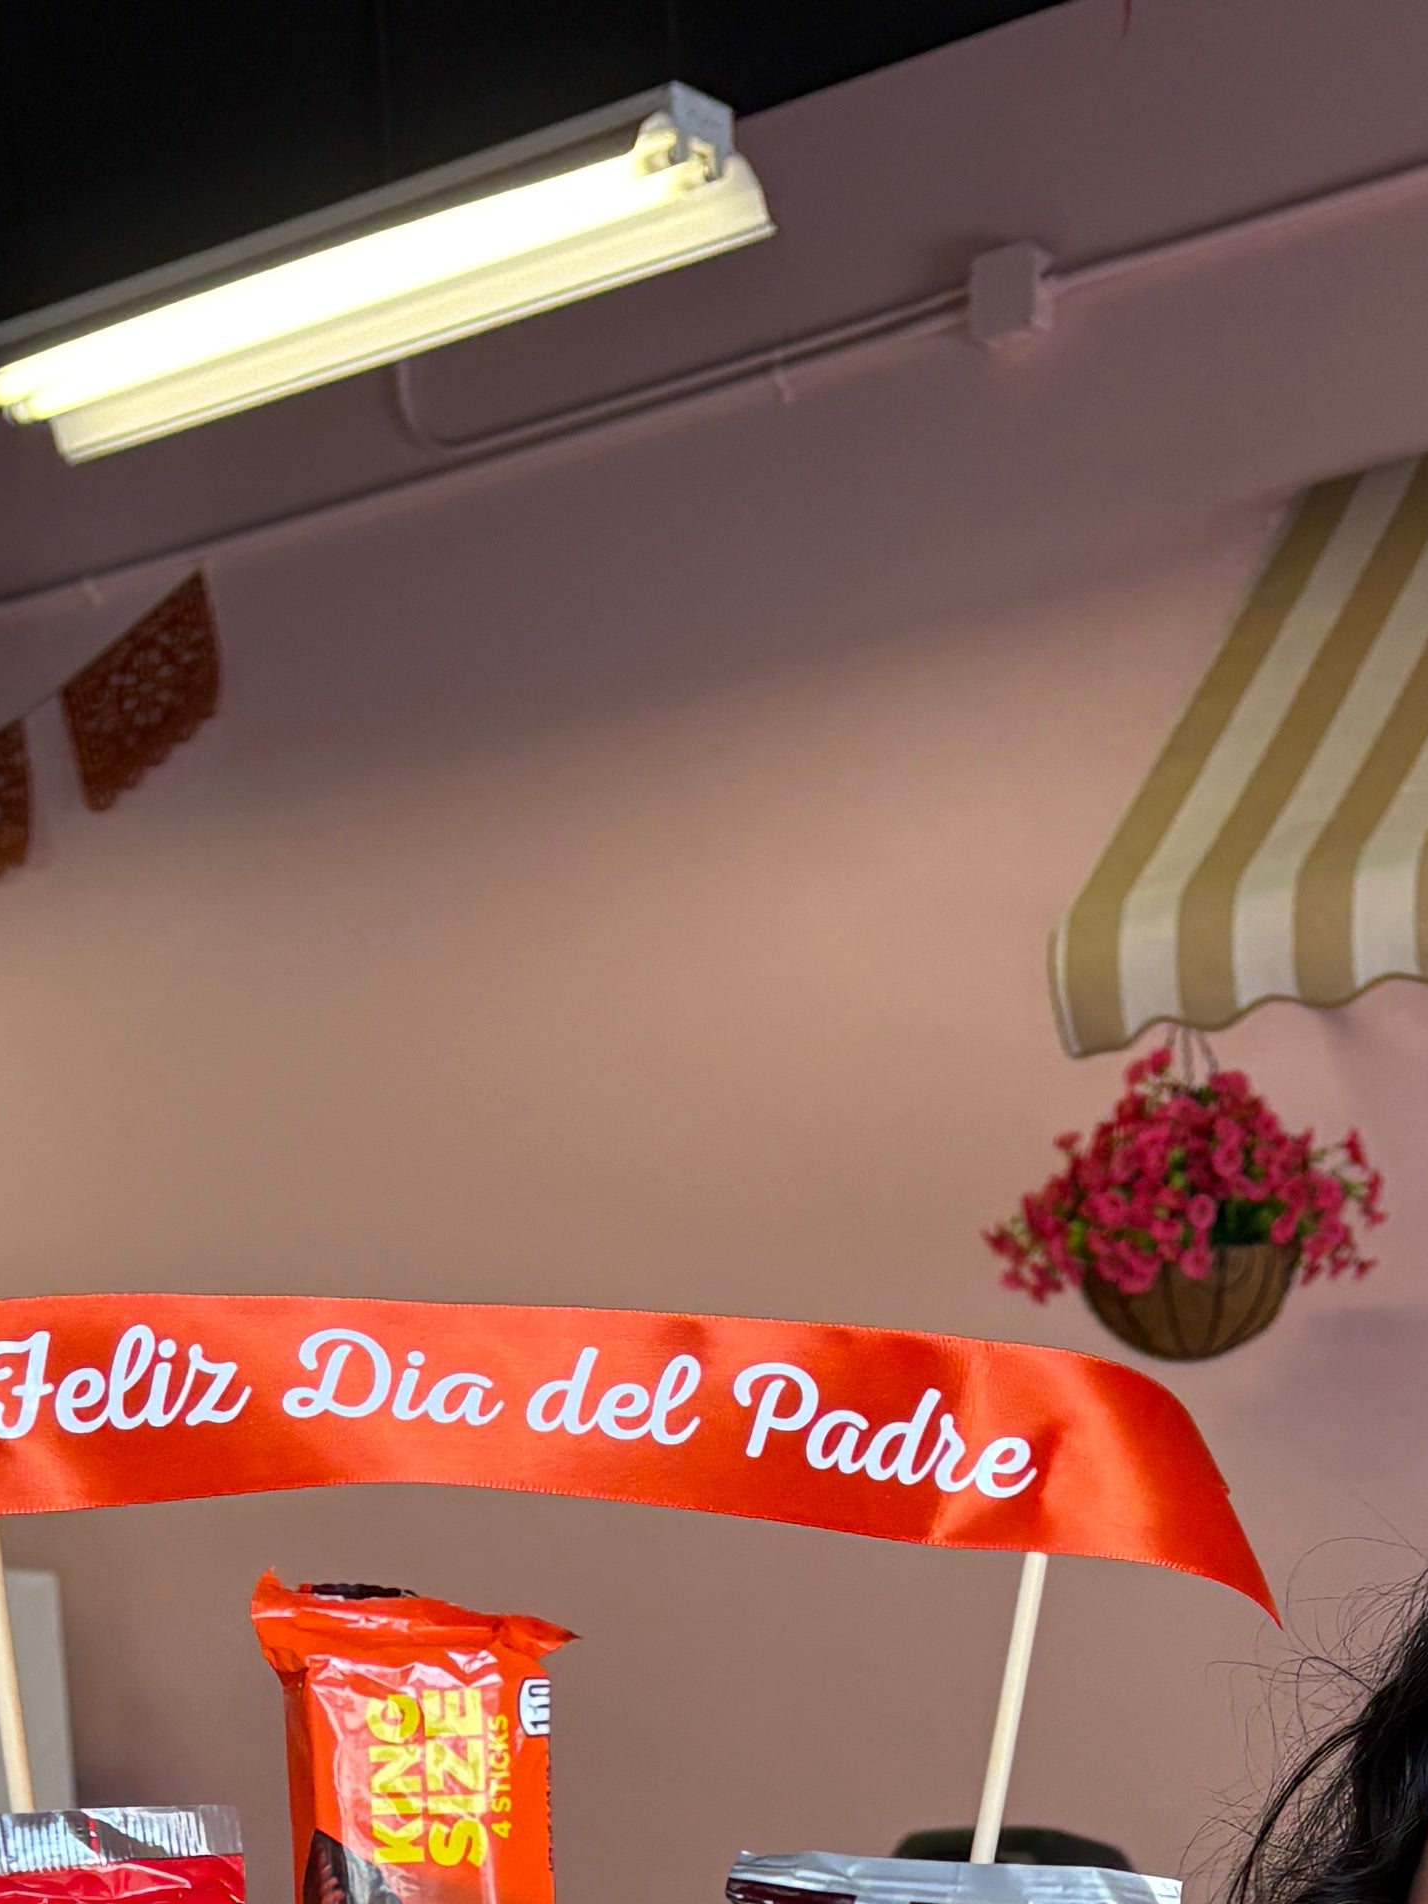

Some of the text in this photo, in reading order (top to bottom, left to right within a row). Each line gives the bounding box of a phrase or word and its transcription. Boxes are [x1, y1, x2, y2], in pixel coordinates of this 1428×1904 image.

[281, 1327, 504, 1426] Dia
[525, 1346, 702, 1447] del
[732, 1361, 1038, 1500] Padre
[365, 1693, 425, 1866] KING
[423, 1687, 487, 1868] SIZE
[490, 1713, 510, 1839] 4 STICKS
